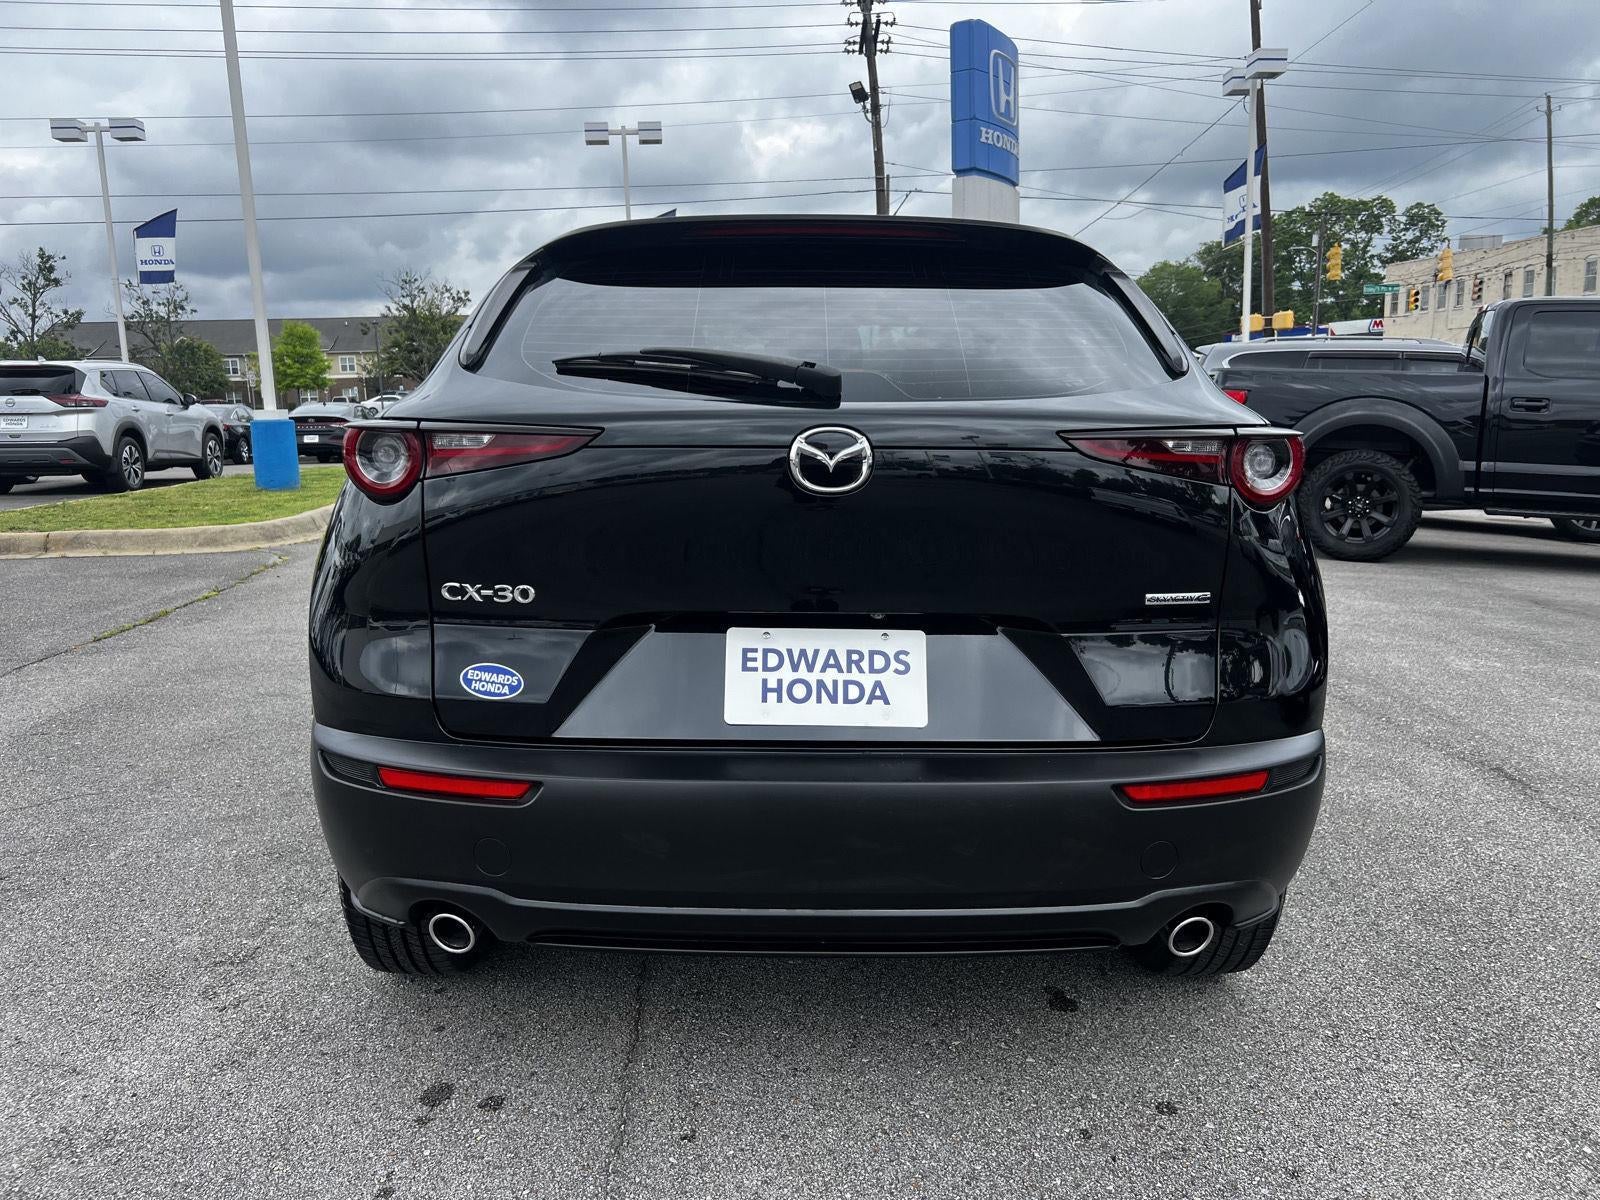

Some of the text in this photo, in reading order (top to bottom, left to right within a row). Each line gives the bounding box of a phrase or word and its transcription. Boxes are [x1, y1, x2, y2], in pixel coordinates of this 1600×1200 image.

[441, 582, 536, 603] CX-30
[741, 648, 911, 675] EDWARDS
[467, 669, 518, 686] EDWARDS
[471, 680, 510, 695] HONDA
[761, 678, 891, 705] HONDA
